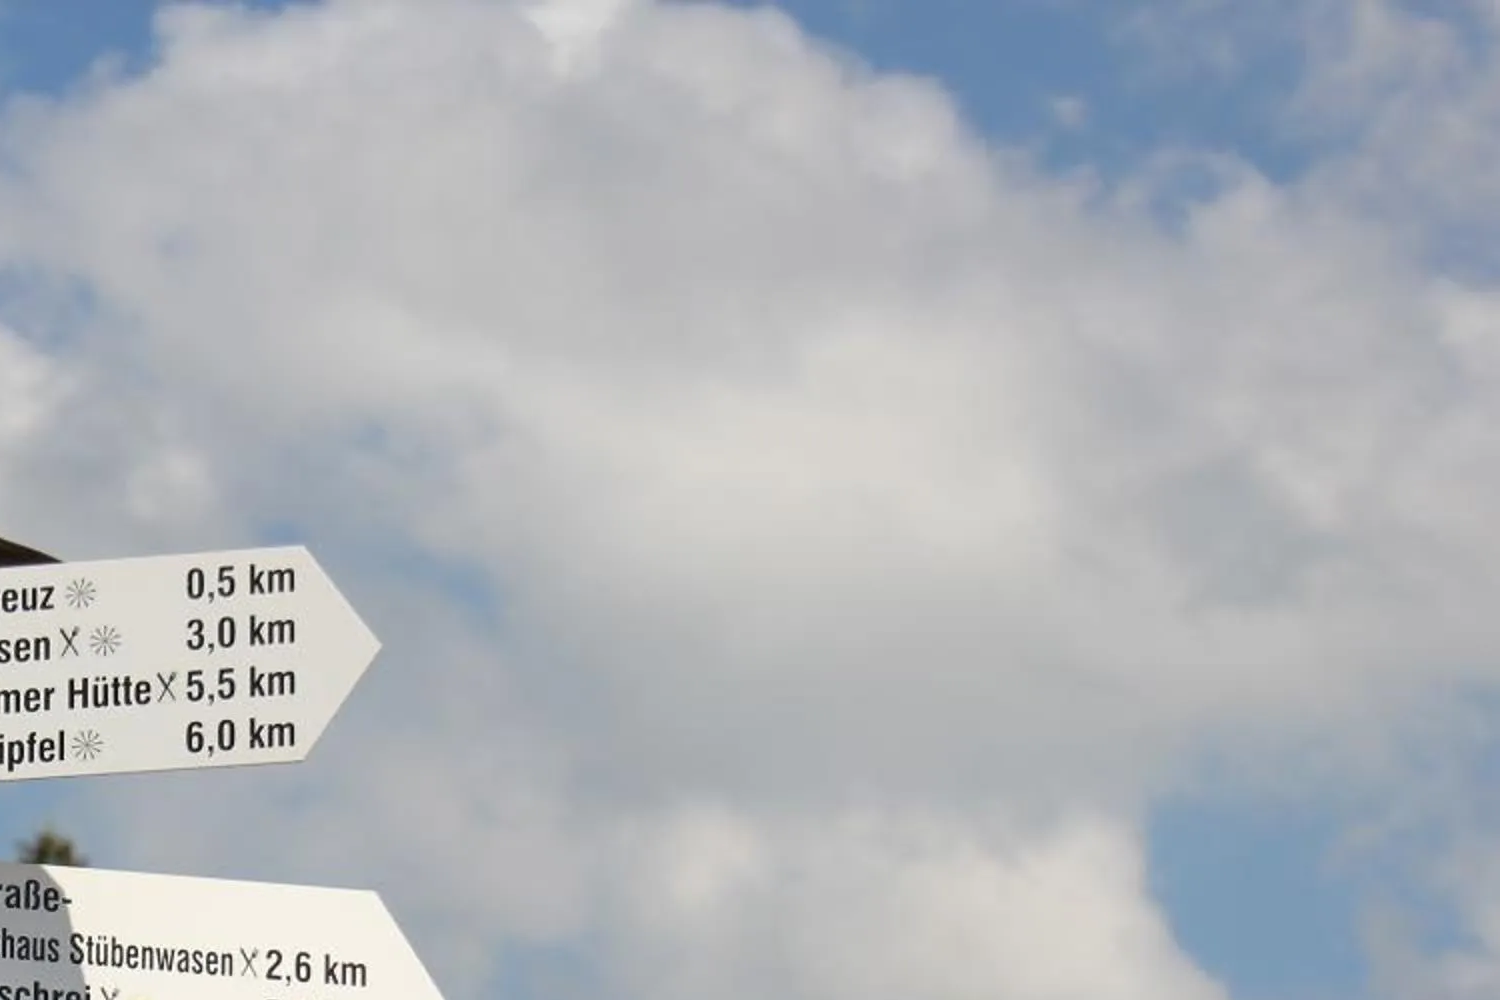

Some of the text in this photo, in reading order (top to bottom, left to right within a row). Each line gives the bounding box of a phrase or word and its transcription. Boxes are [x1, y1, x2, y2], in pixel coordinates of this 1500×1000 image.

[186, 565, 236, 603] 0,5
[249, 563, 295, 595] km
[186, 616, 237, 654] 3,0
[249, 614, 295, 647] km
[67, 675, 152, 710] Hütte
[186, 667, 236, 704] 5,5
[249, 665, 296, 698] km
[185, 719, 236, 757] 6,0
[249, 717, 295, 749] km
[68, 932, 234, 977] Stübenwasen
[265, 949, 312, 984] 2,6
[324, 953, 367, 988] km
